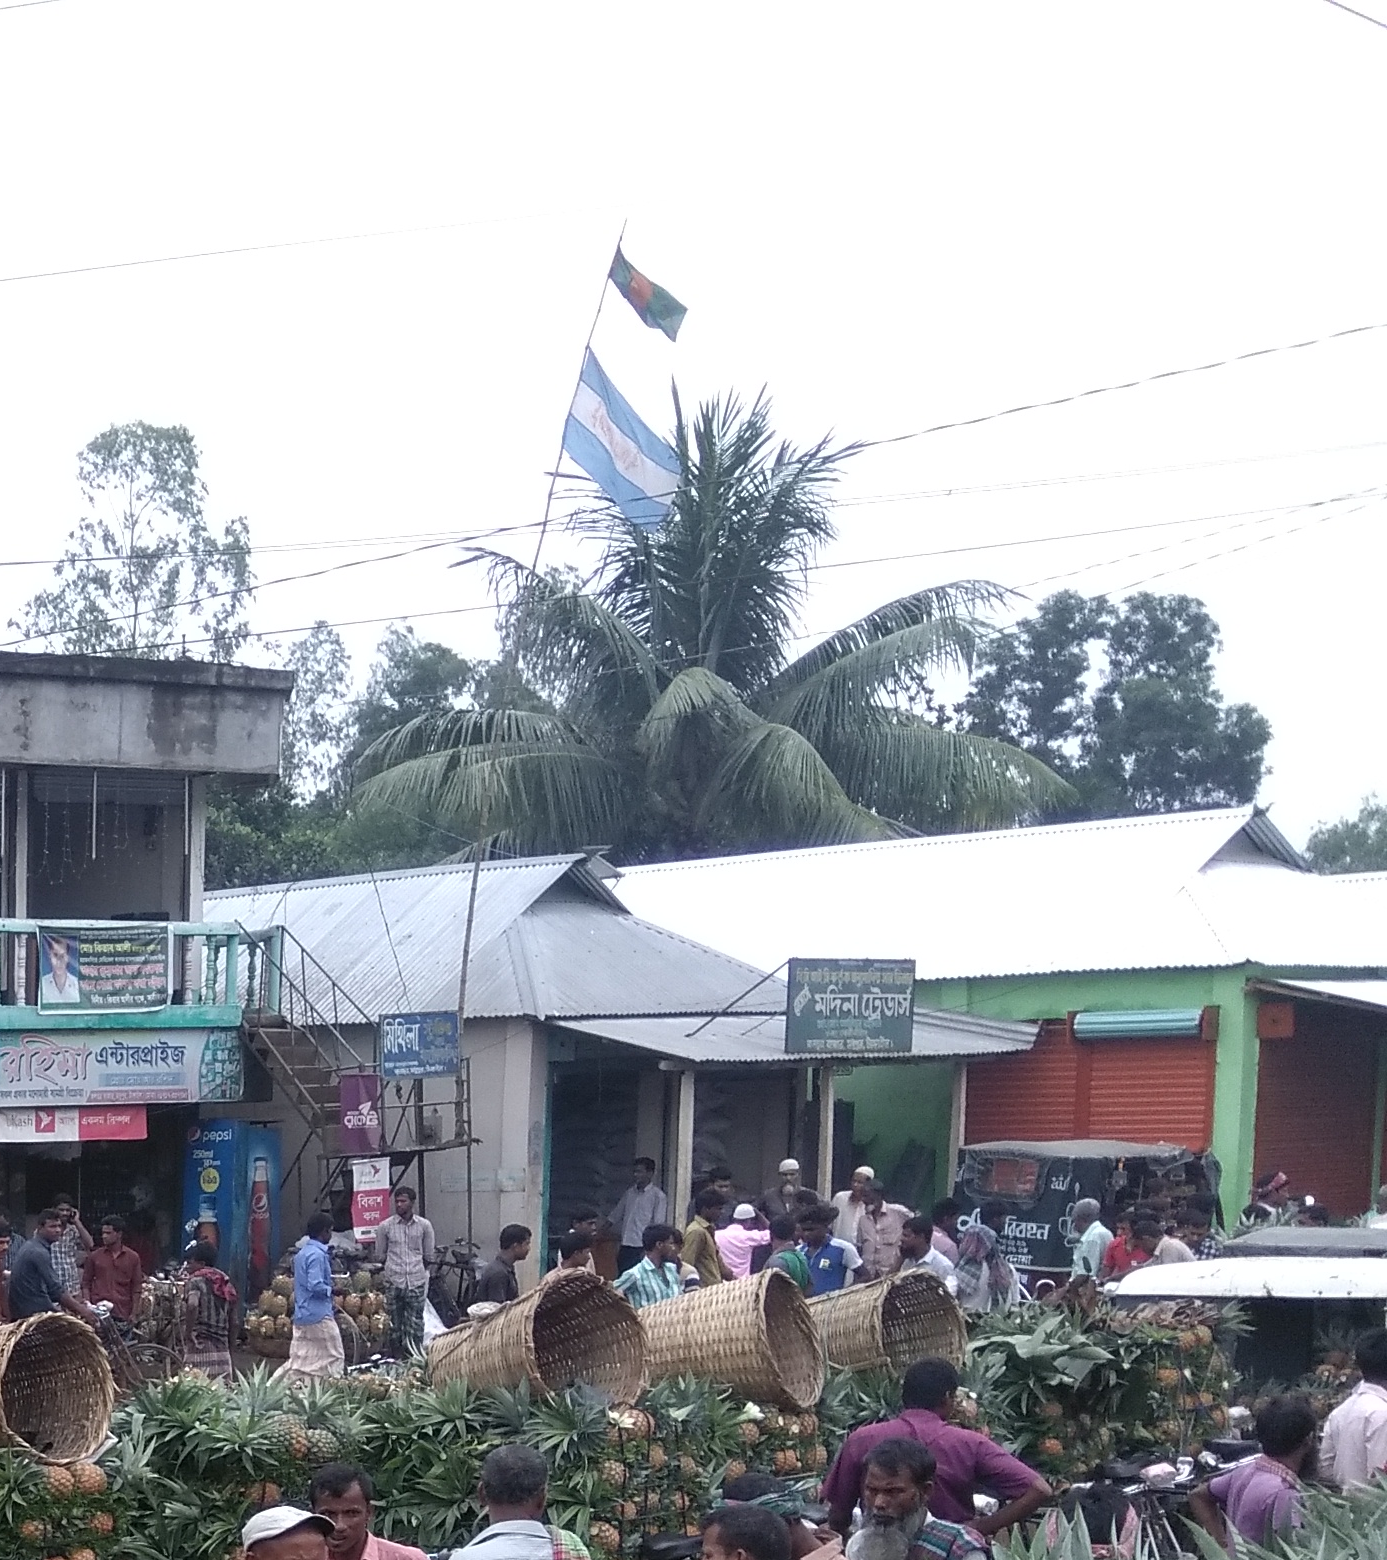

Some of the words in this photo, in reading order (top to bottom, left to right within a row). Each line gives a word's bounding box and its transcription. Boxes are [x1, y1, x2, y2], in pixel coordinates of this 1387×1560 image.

[814, 984, 859, 1017] মদিনা
[862, 986, 912, 1020] ট্রেডার্স
[0, 1033, 94, 1085] রহিমা
[94, 1039, 187, 1068] এন্টারপ্রাইজ
[202, 1129, 232, 1143] pepsi
